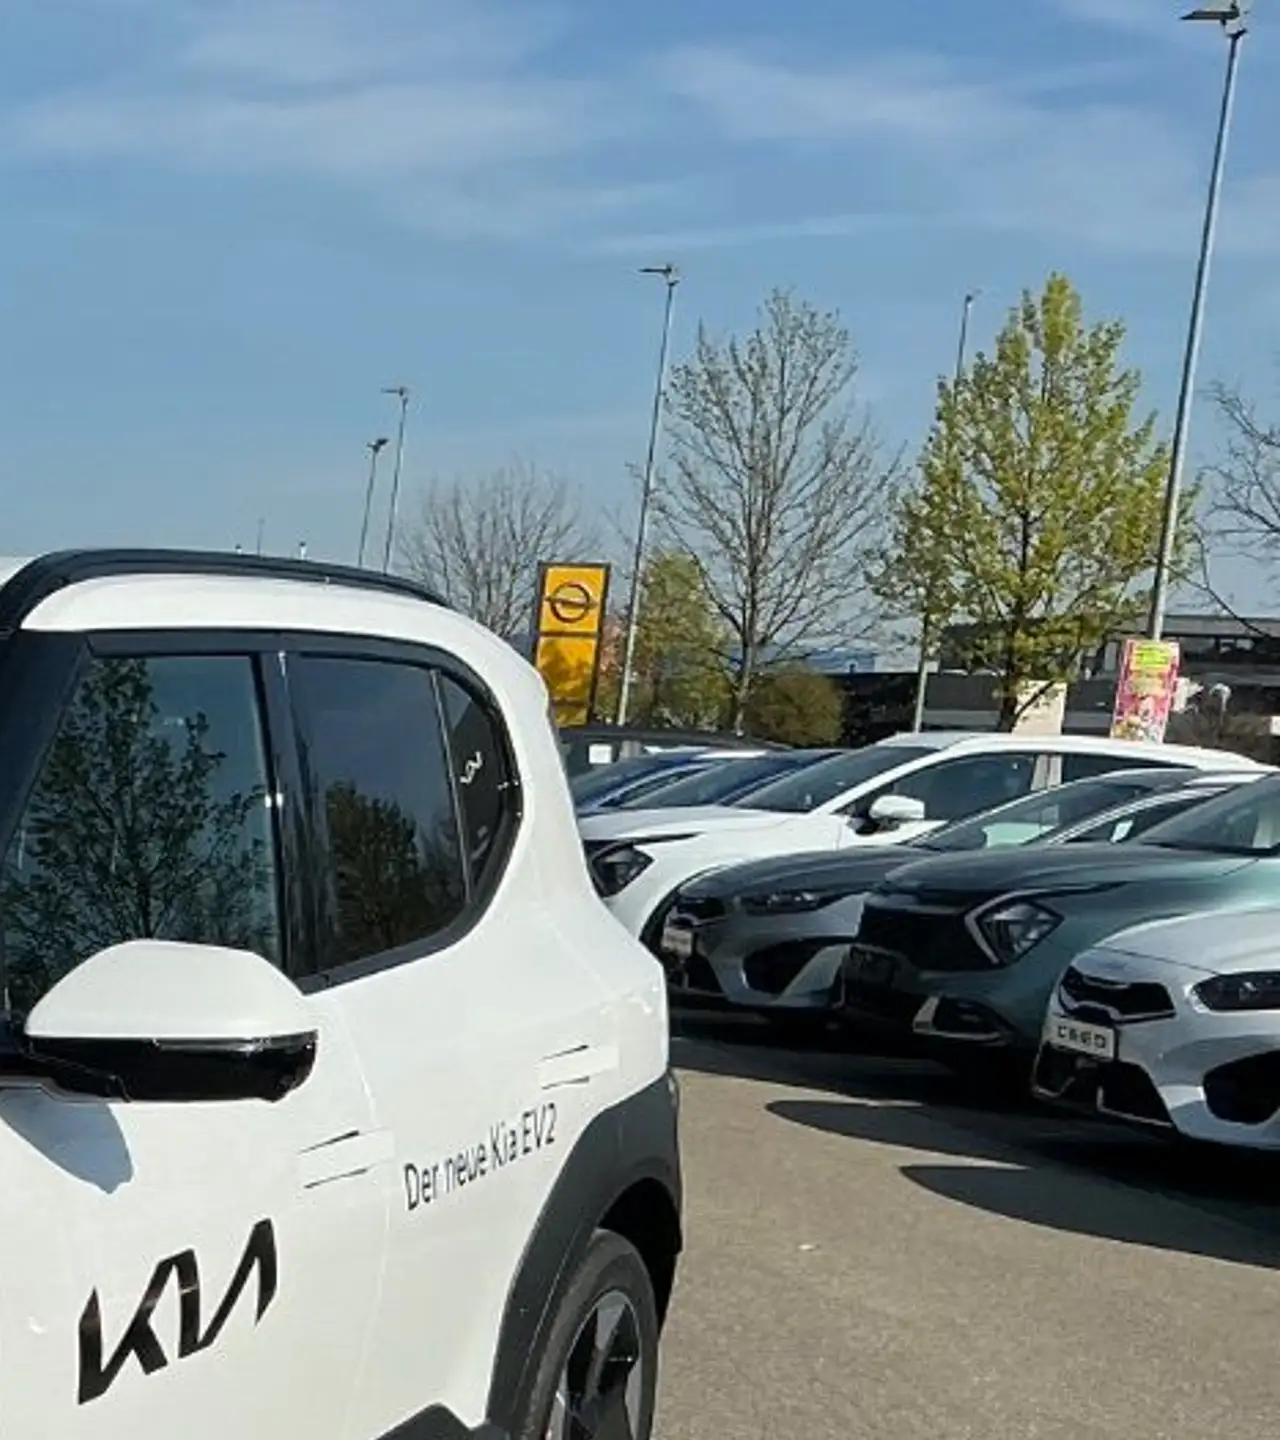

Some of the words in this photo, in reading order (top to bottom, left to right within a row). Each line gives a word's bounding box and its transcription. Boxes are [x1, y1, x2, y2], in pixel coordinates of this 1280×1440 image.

[403, 1163, 438, 1211] Der
[445, 1143, 486, 1193] neue
[490, 1120, 517, 1171] Kia
[522, 1102, 557, 1155] EV2
[78, 1217, 278, 1405] KIA
